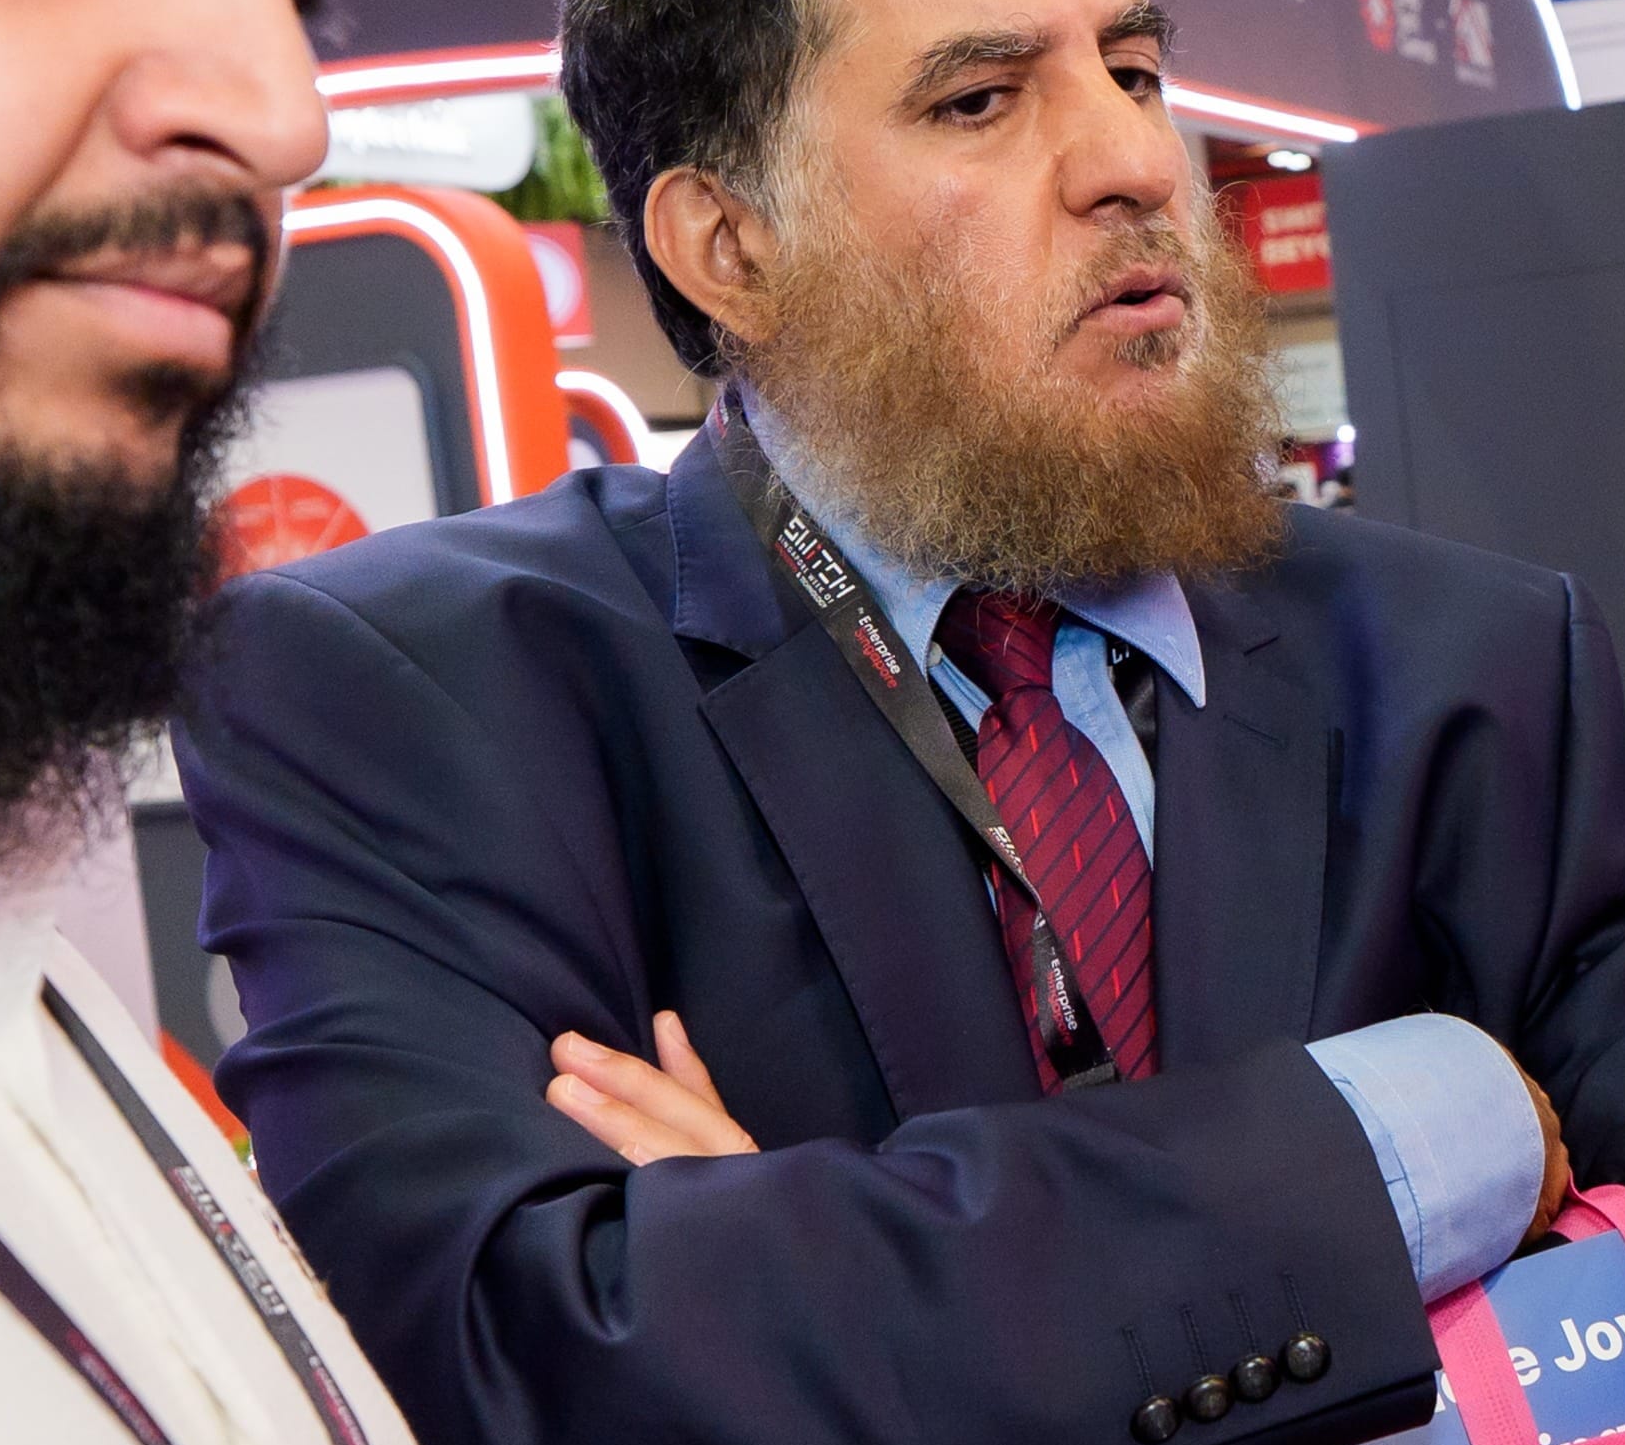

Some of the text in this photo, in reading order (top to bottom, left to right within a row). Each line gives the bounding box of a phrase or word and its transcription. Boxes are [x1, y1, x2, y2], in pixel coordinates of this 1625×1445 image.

[854, 627, 898, 689] Singapore
[858, 615, 901, 675] Enterprise
[1050, 958, 1079, 1031] Enterprise
